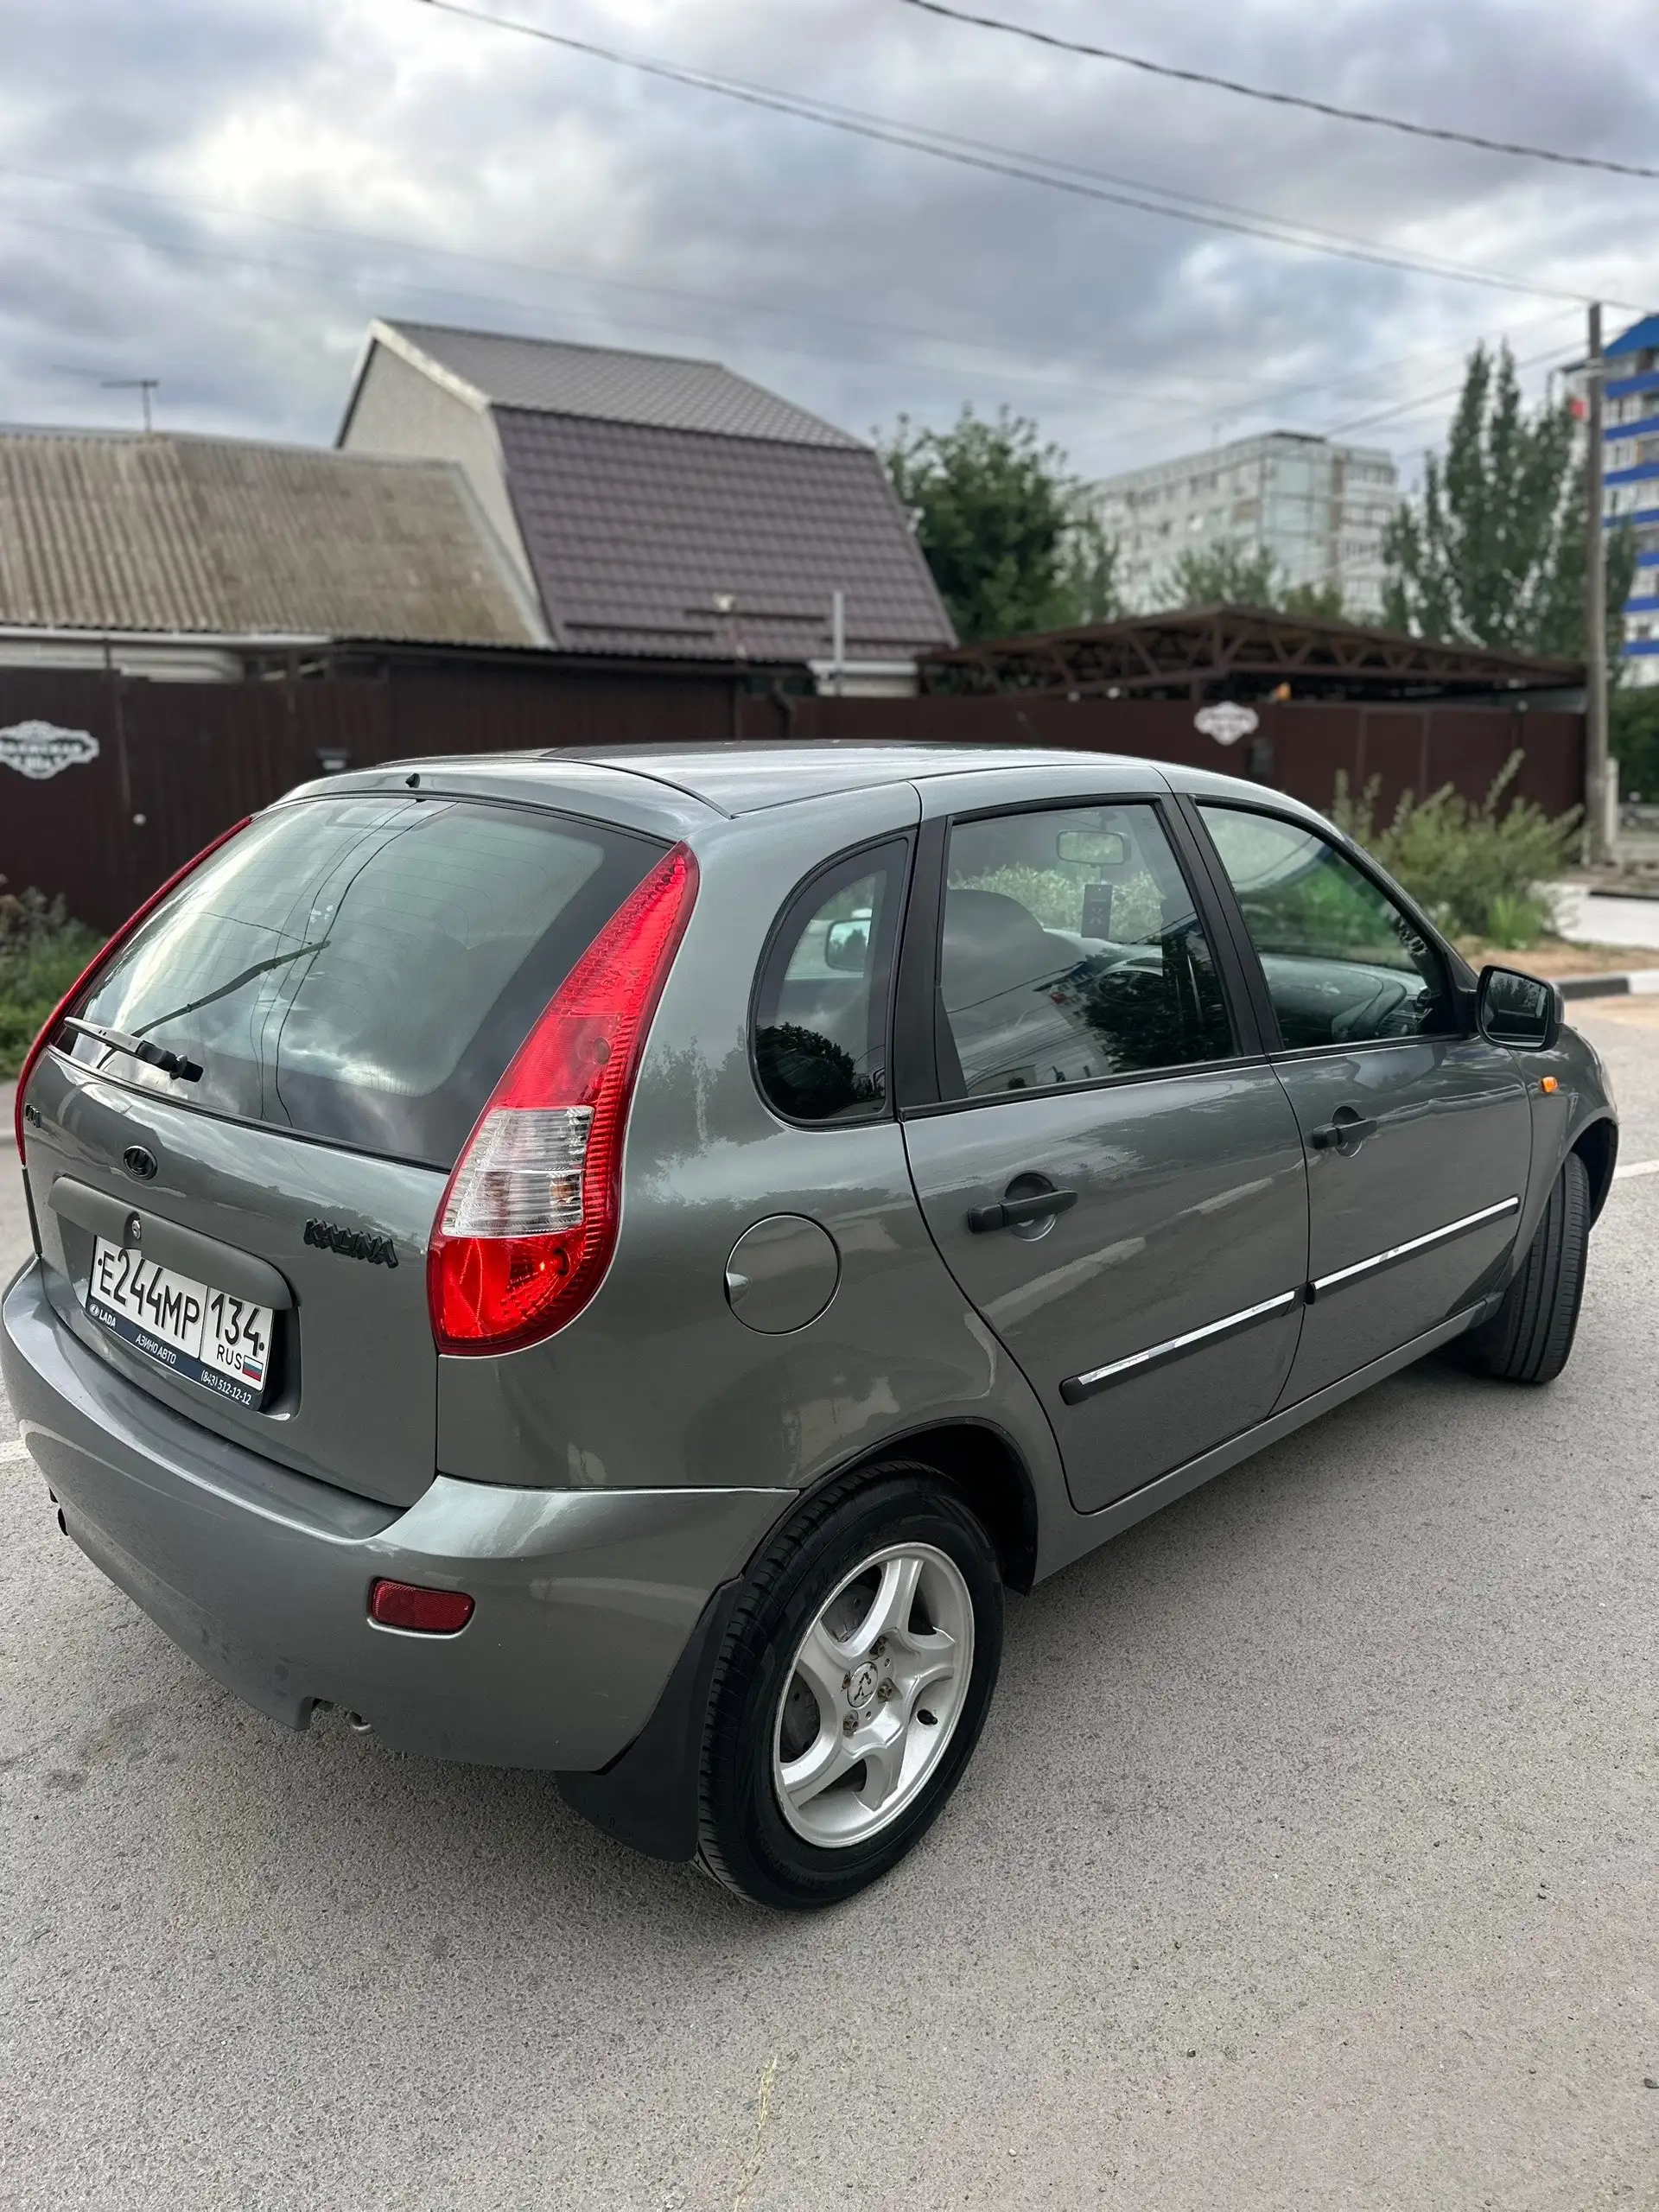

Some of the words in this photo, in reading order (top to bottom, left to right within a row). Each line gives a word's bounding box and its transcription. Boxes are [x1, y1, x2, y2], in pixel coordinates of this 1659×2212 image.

[303, 1217, 399, 1268] KALINA
[99, 1309, 117, 1327] LADA
[211, 1293, 260, 1357] 134
[135, 1333, 158, 1354] АЗИНО
[156, 1346, 177, 1364] АВТО
[216, 1344, 242, 1370] RUS
[217, 1379, 252, 1406] 512-12-12
